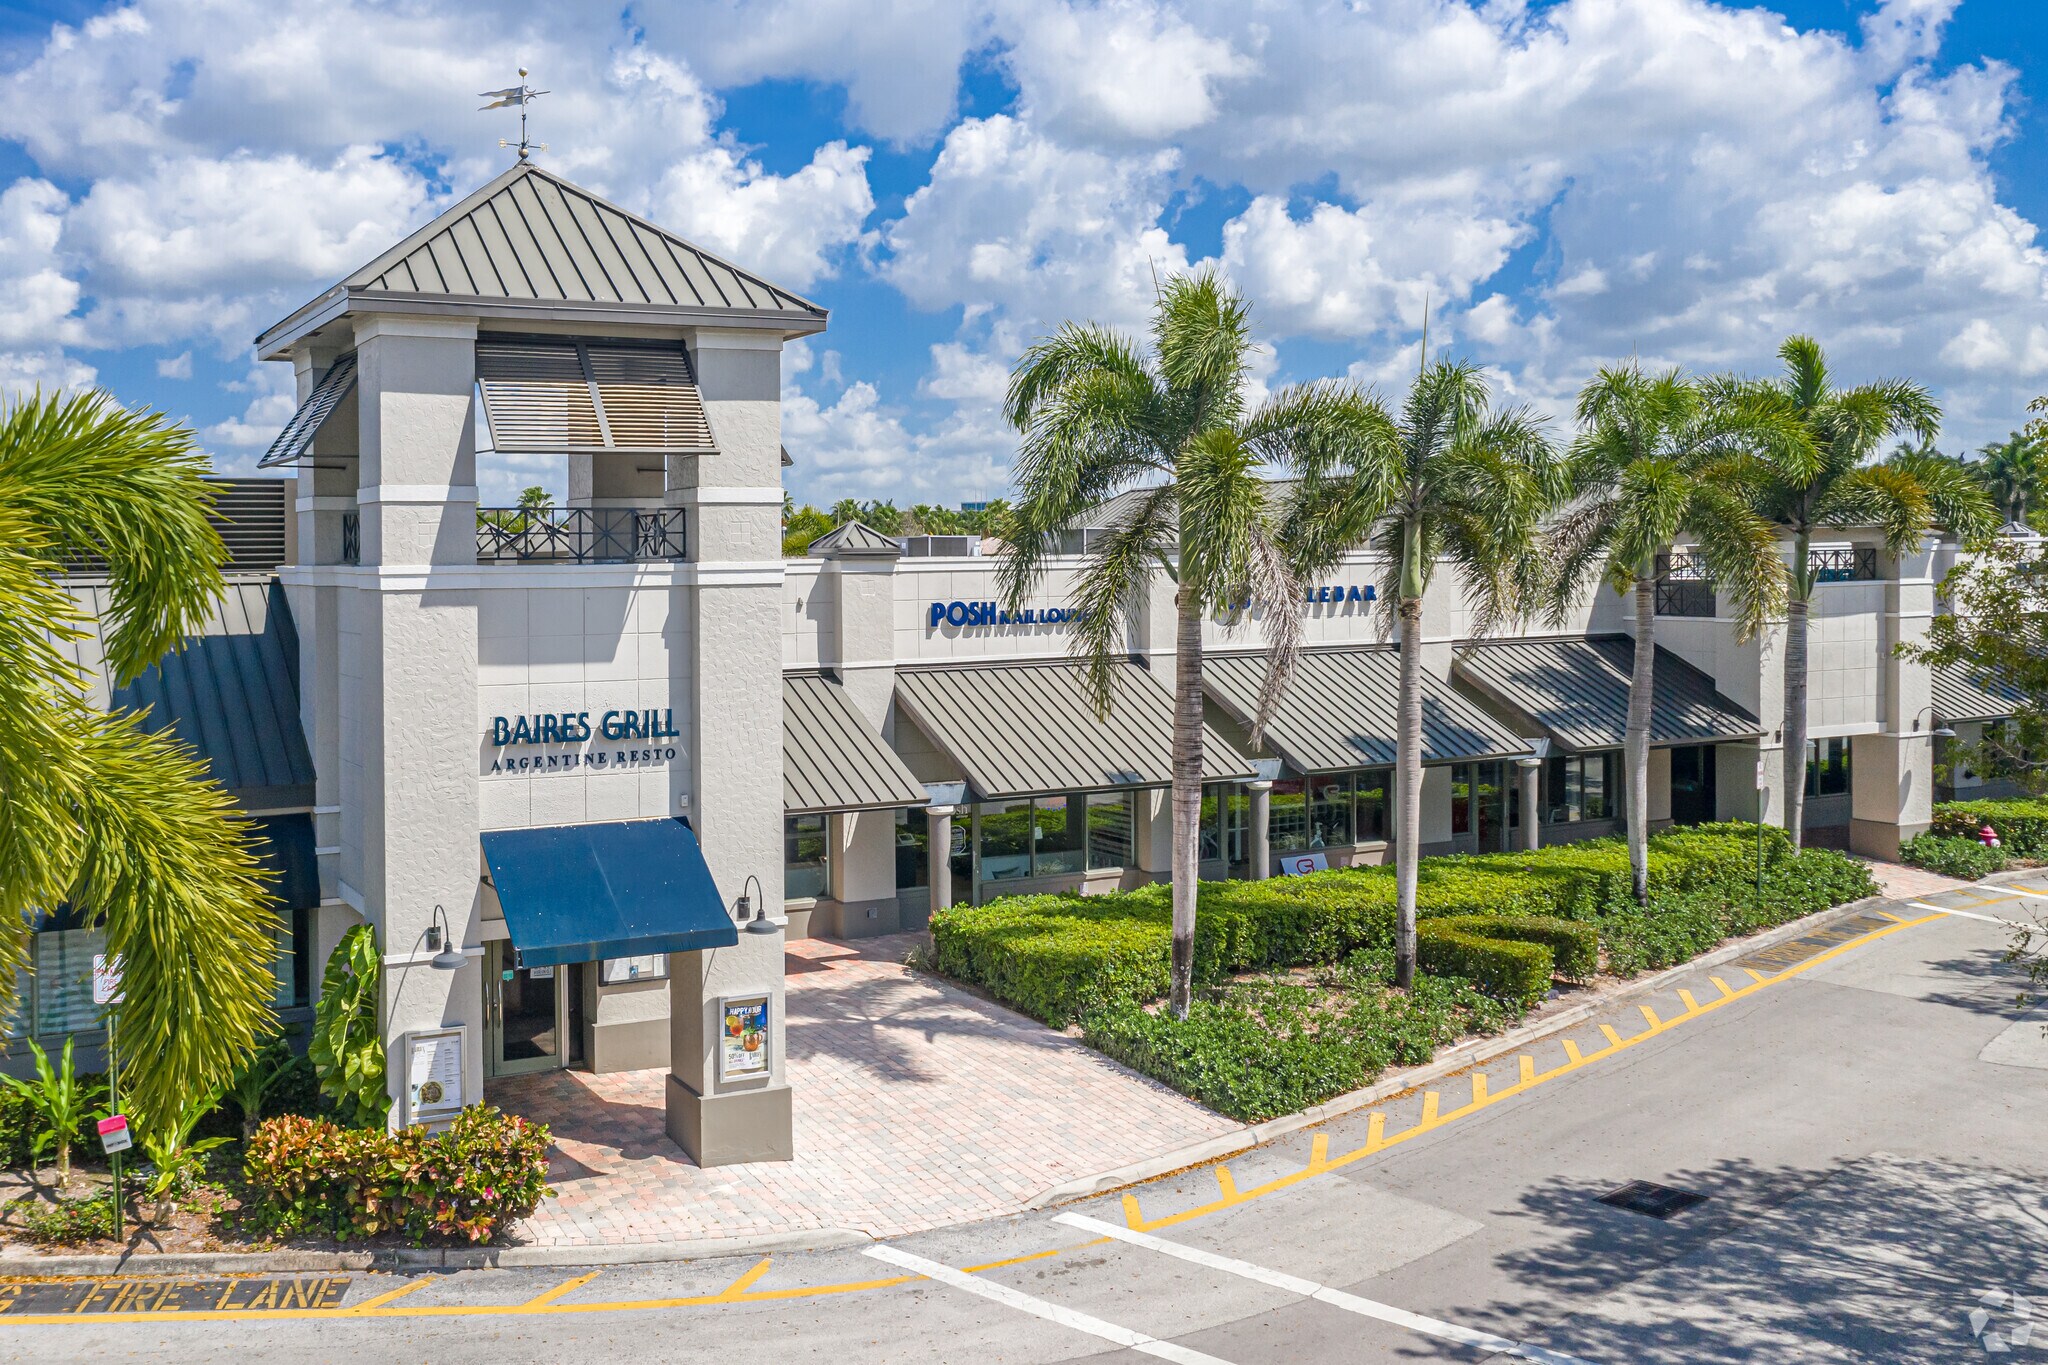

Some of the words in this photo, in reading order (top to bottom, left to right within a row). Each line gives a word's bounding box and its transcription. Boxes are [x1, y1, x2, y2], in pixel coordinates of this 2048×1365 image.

[931, 601, 997, 627] POSH
[999, 609, 1038, 625] NAIL
[493, 711, 592, 747] BAIRES
[600, 708, 681, 741] GRILL
[491, 751, 607, 771] ARGENTINE
[616, 748, 677, 764] RESTO
[75, 1280, 199, 1313] FIRE
[214, 1277, 352, 1310] LANE
